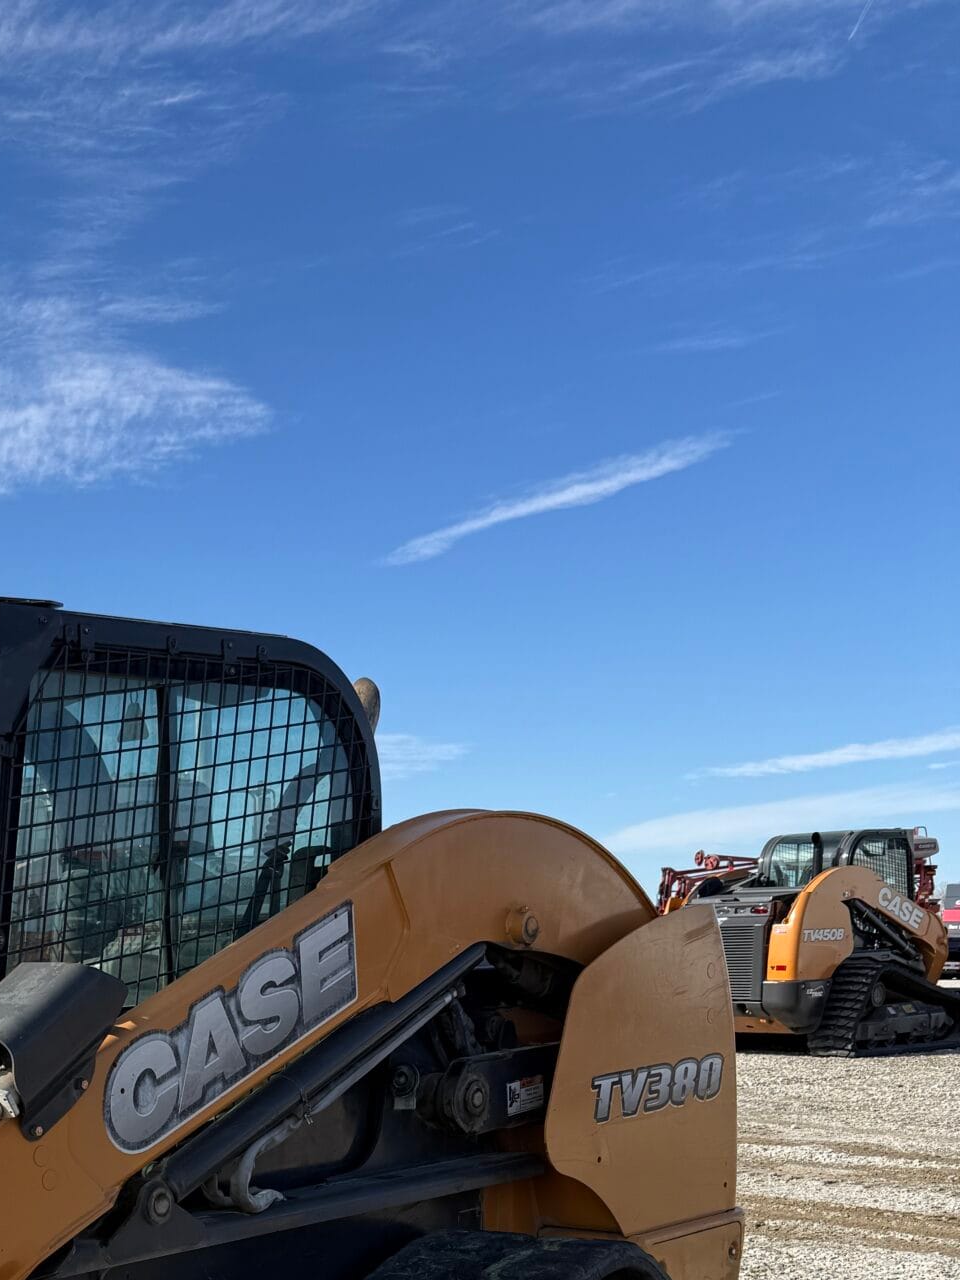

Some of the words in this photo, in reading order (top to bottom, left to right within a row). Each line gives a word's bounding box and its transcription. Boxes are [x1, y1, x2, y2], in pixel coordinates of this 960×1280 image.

[803, 928, 845, 942] TV450B
[878, 887, 924, 929] CASE
[106, 903, 354, 1148] CASE
[592, 1054, 724, 1122] TV380
